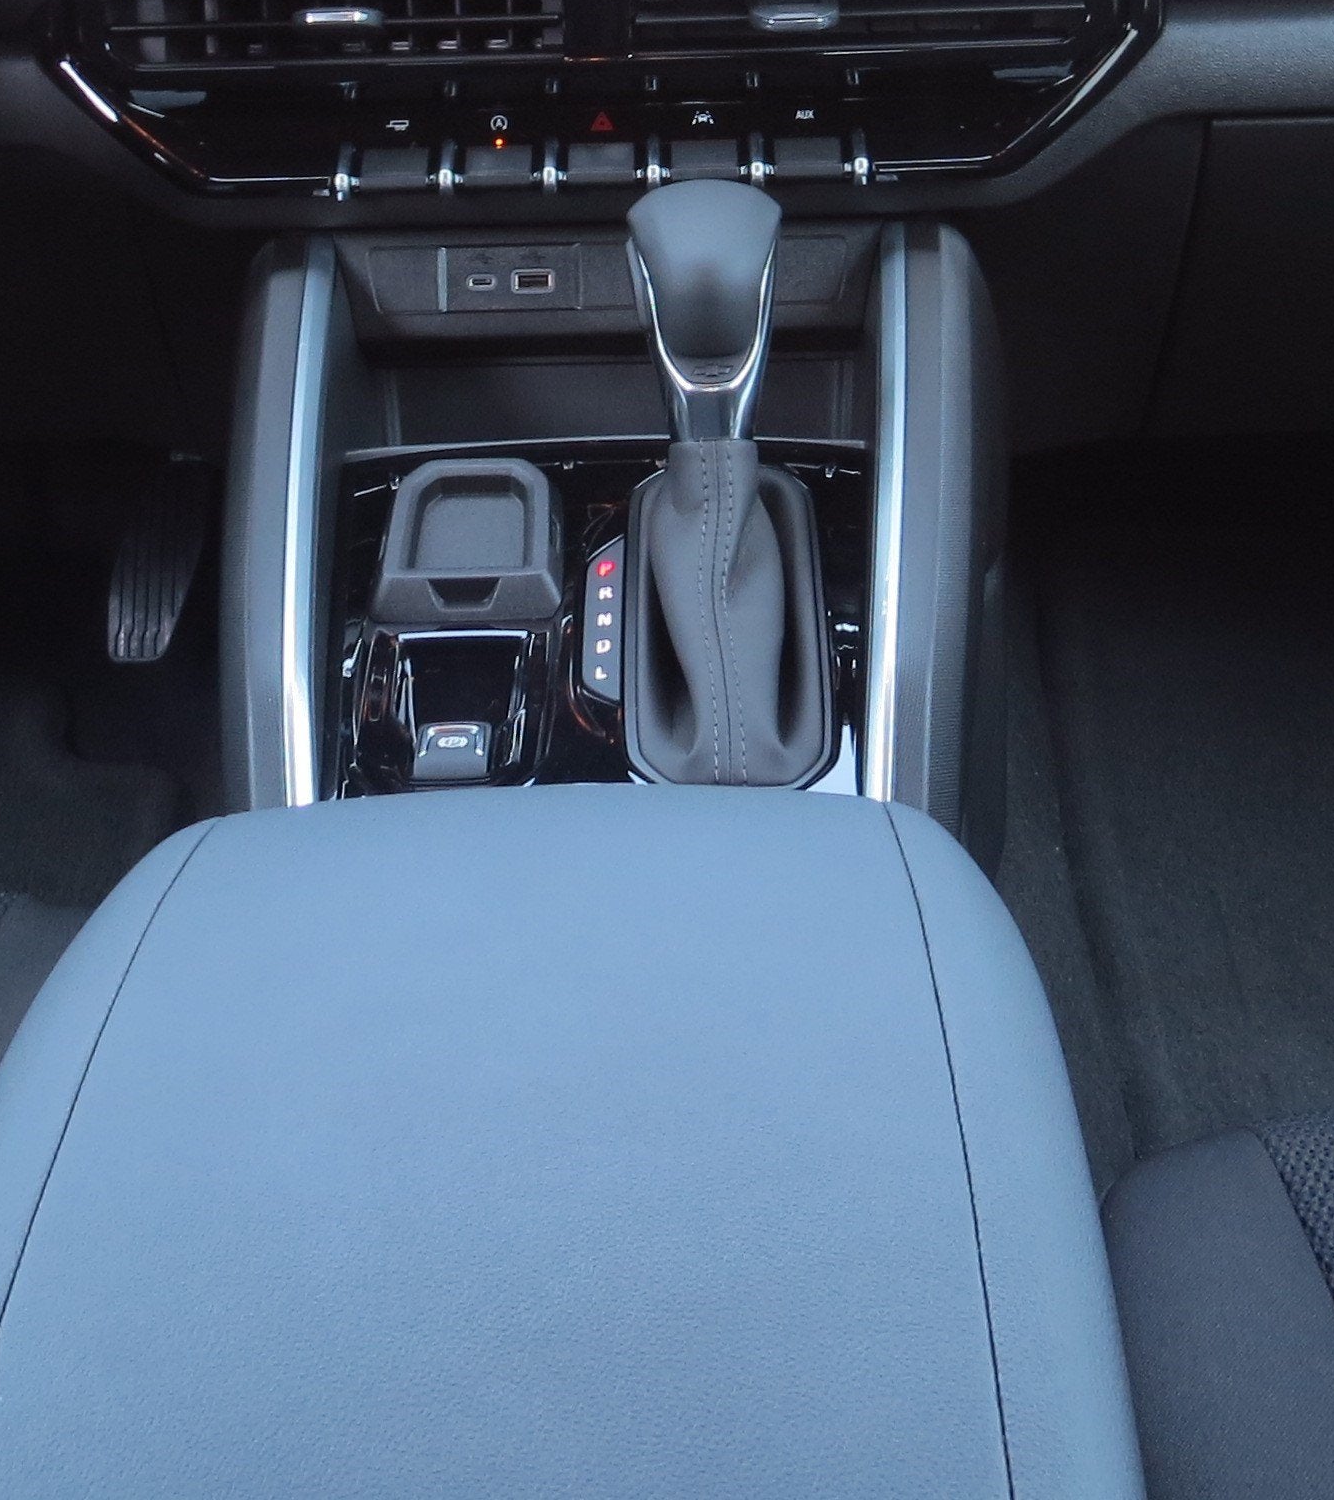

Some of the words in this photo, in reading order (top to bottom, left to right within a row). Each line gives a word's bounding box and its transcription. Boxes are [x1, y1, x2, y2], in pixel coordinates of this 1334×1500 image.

[795, 109, 815, 120] AUX
[597, 560, 616, 577] P
[598, 585, 614, 600] R
[597, 612, 613, 627] N
[595, 638, 612, 655] D
[594, 665, 608, 680] L
